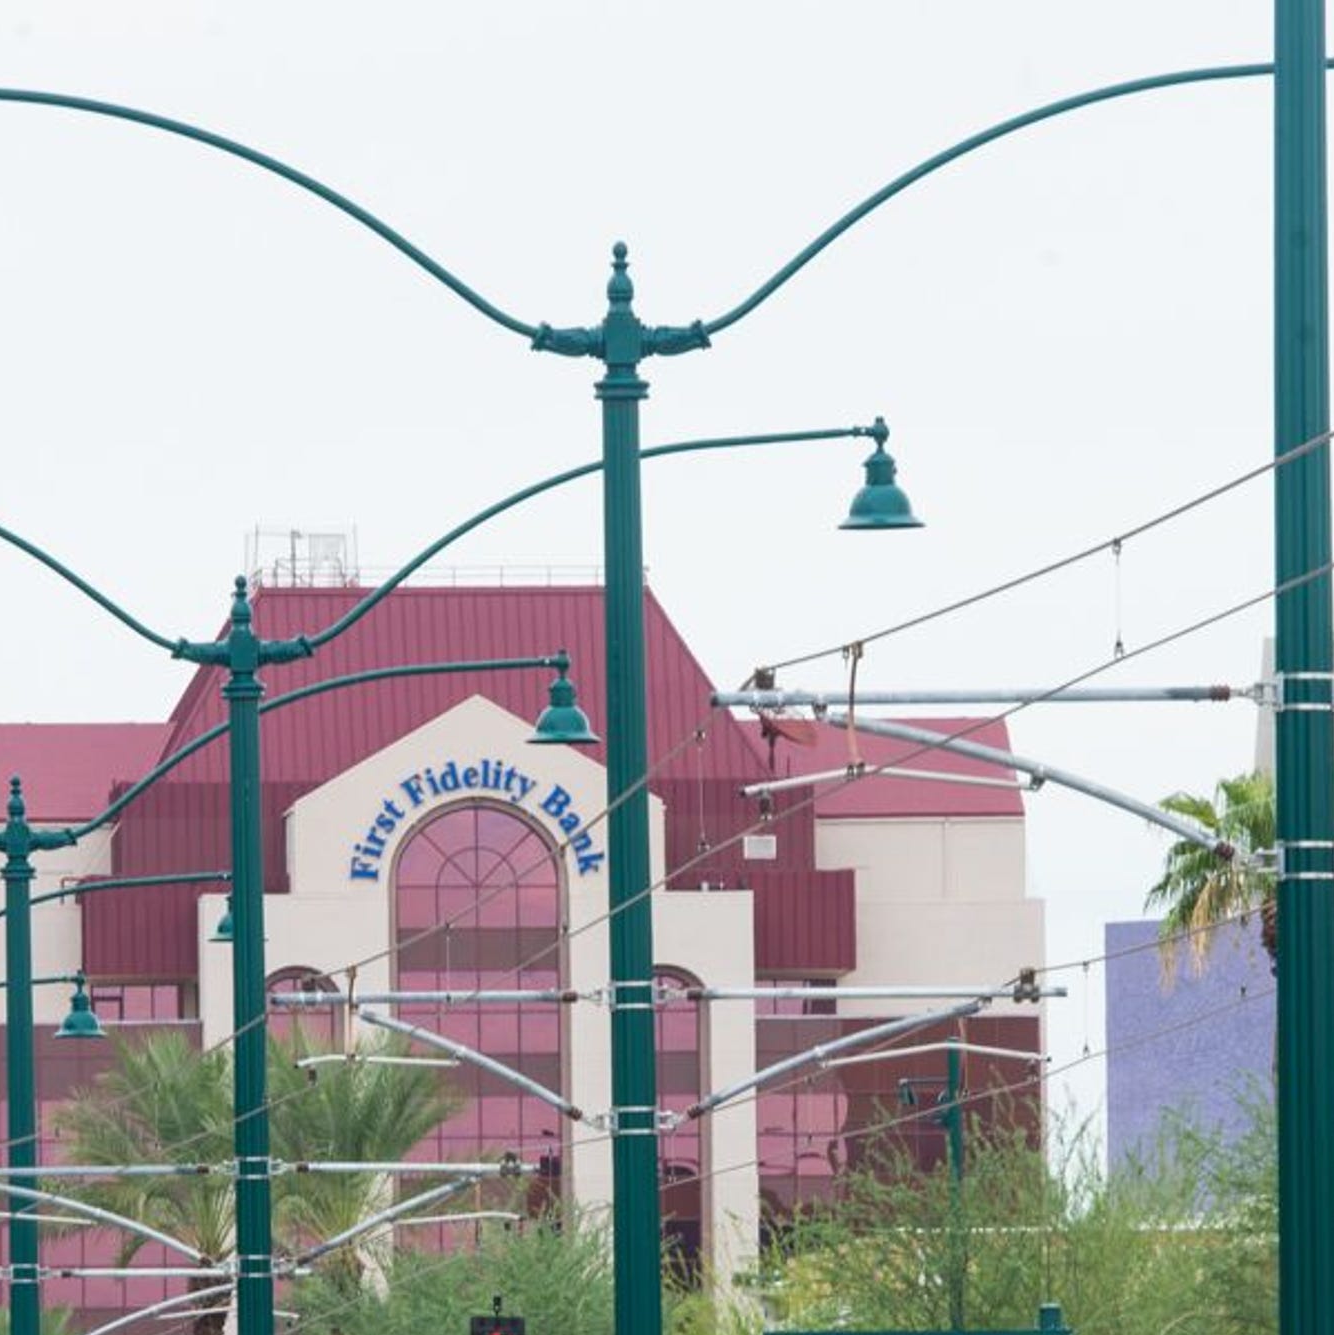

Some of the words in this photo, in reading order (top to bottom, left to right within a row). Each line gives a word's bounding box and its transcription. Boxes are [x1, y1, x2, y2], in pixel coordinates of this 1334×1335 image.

[350, 798, 406, 882] First
[400, 759, 537, 808] Fidelity
[540, 783, 606, 876] Bank
